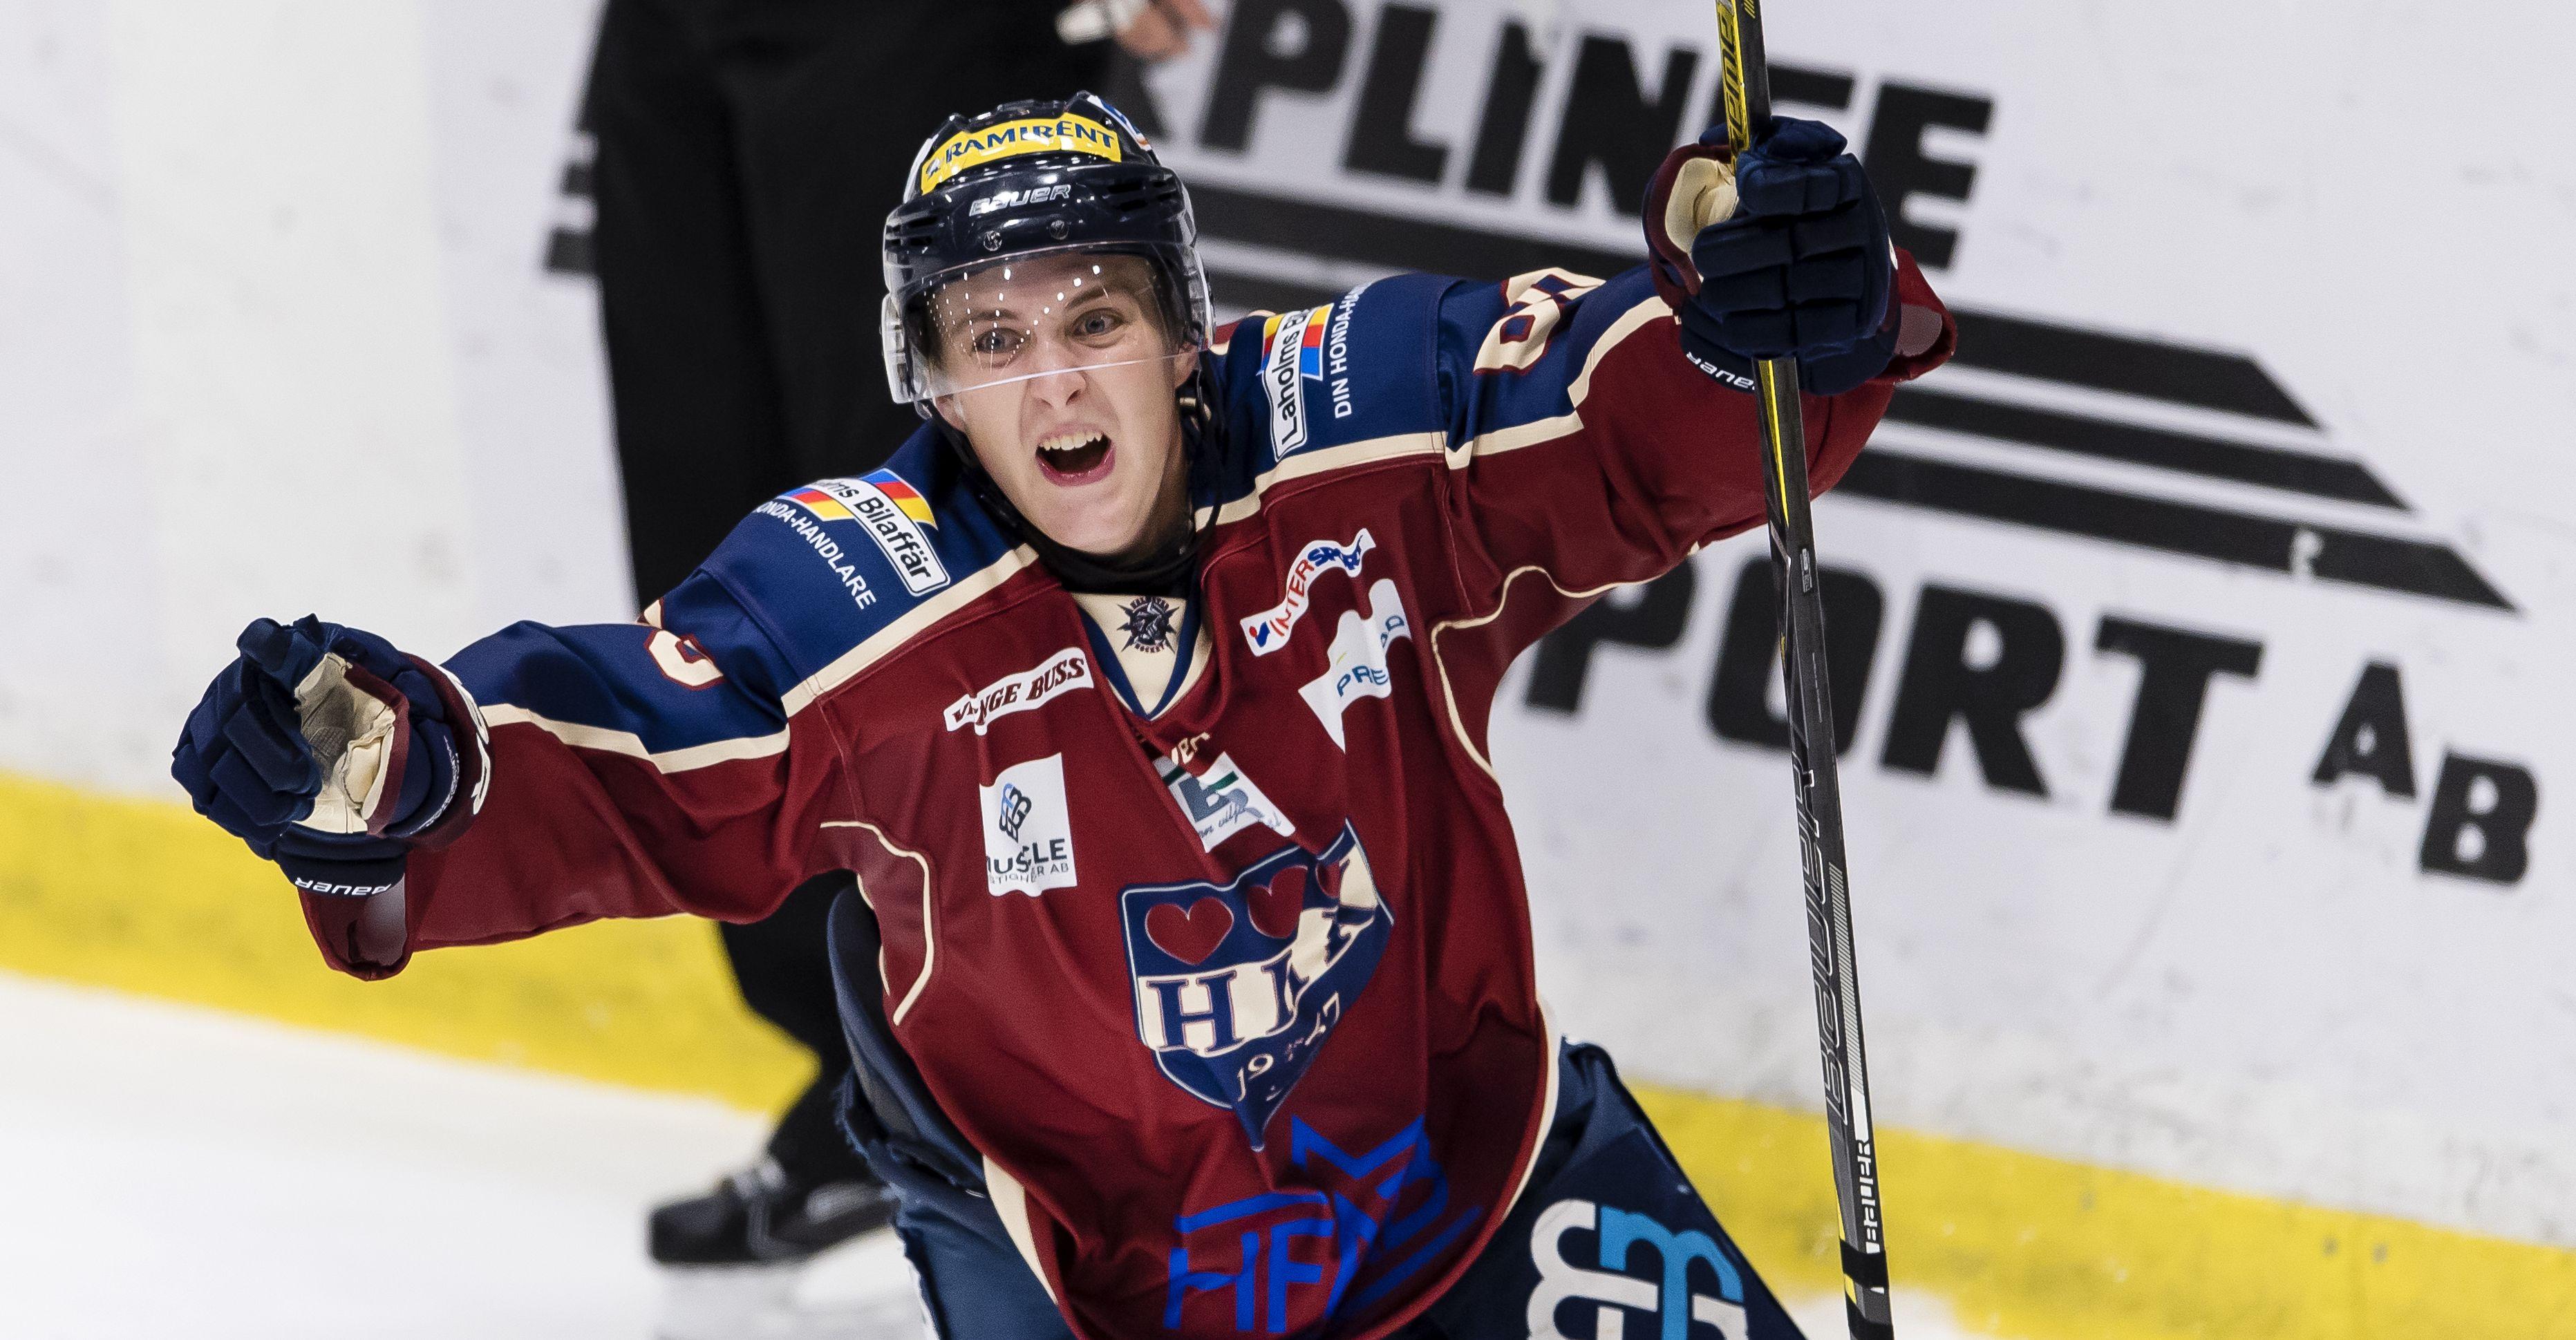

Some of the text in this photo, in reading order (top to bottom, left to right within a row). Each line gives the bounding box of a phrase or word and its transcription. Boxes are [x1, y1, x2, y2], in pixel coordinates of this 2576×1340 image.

[946, 120, 1114, 163] RAMIRENT
[968, 184, 1071, 217] BAUER
[1272, 329, 1300, 446] Laholms
[1331, 377, 1353, 419] DIN
[854, 496, 932, 578] Bilaffär
[1026, 657, 1085, 701] BUSS
[2312, 660, 2539, 885] AB
